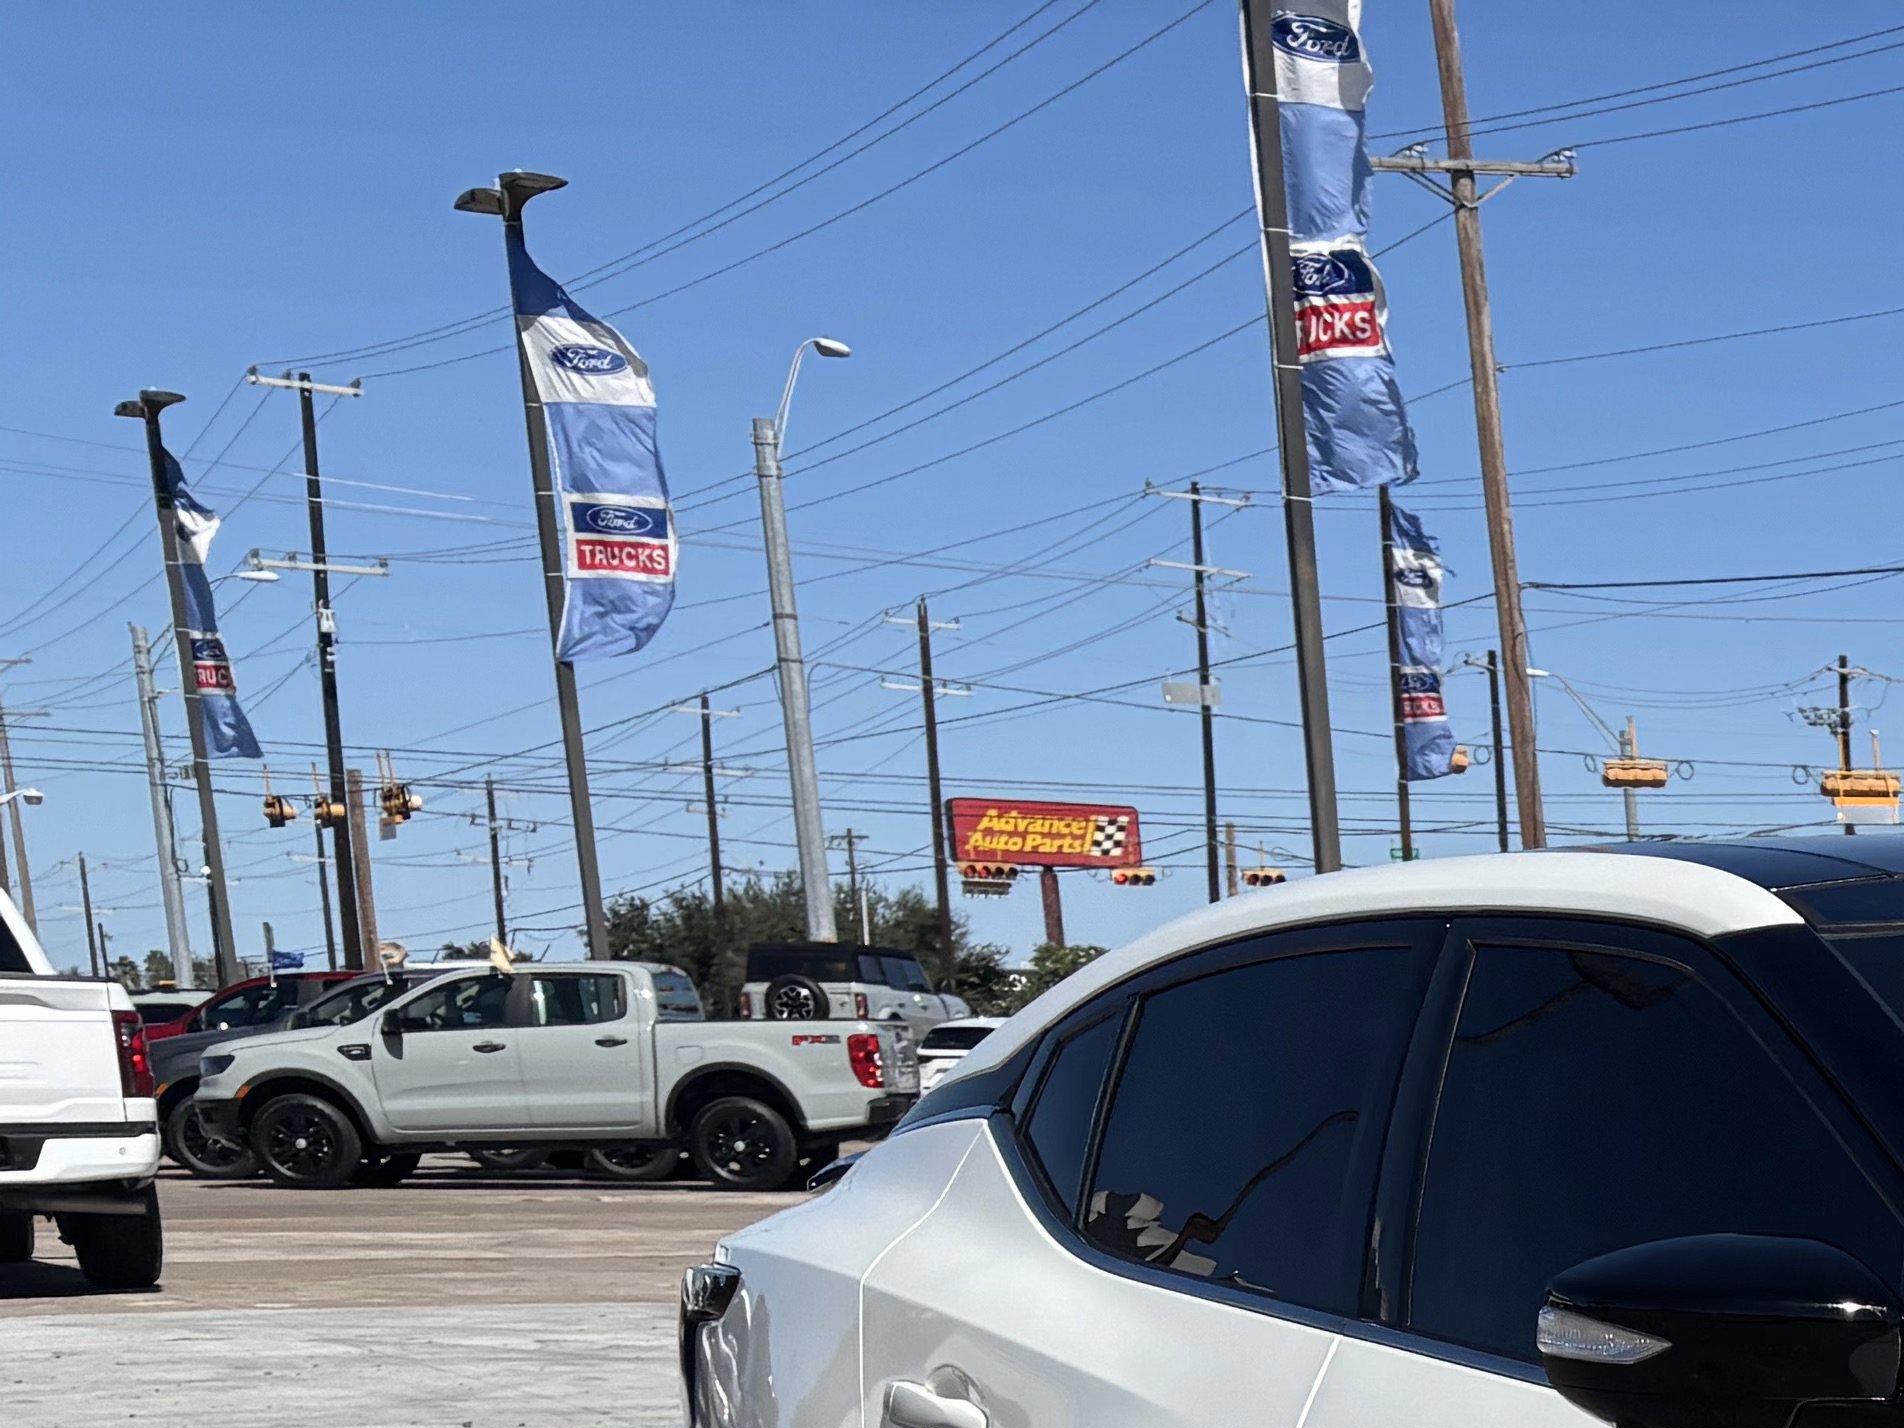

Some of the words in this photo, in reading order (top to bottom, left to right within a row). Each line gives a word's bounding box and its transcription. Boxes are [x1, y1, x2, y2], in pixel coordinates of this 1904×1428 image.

[1286, 21, 1352, 57] Ford
[565, 348, 613, 370] Ford
[597, 509, 640, 529] Ford
[580, 544, 666, 571] TRUCKS
[977, 808, 1087, 835] Advance
[965, 831, 1022, 851] Auto
[1022, 834, 1082, 853] Parts
